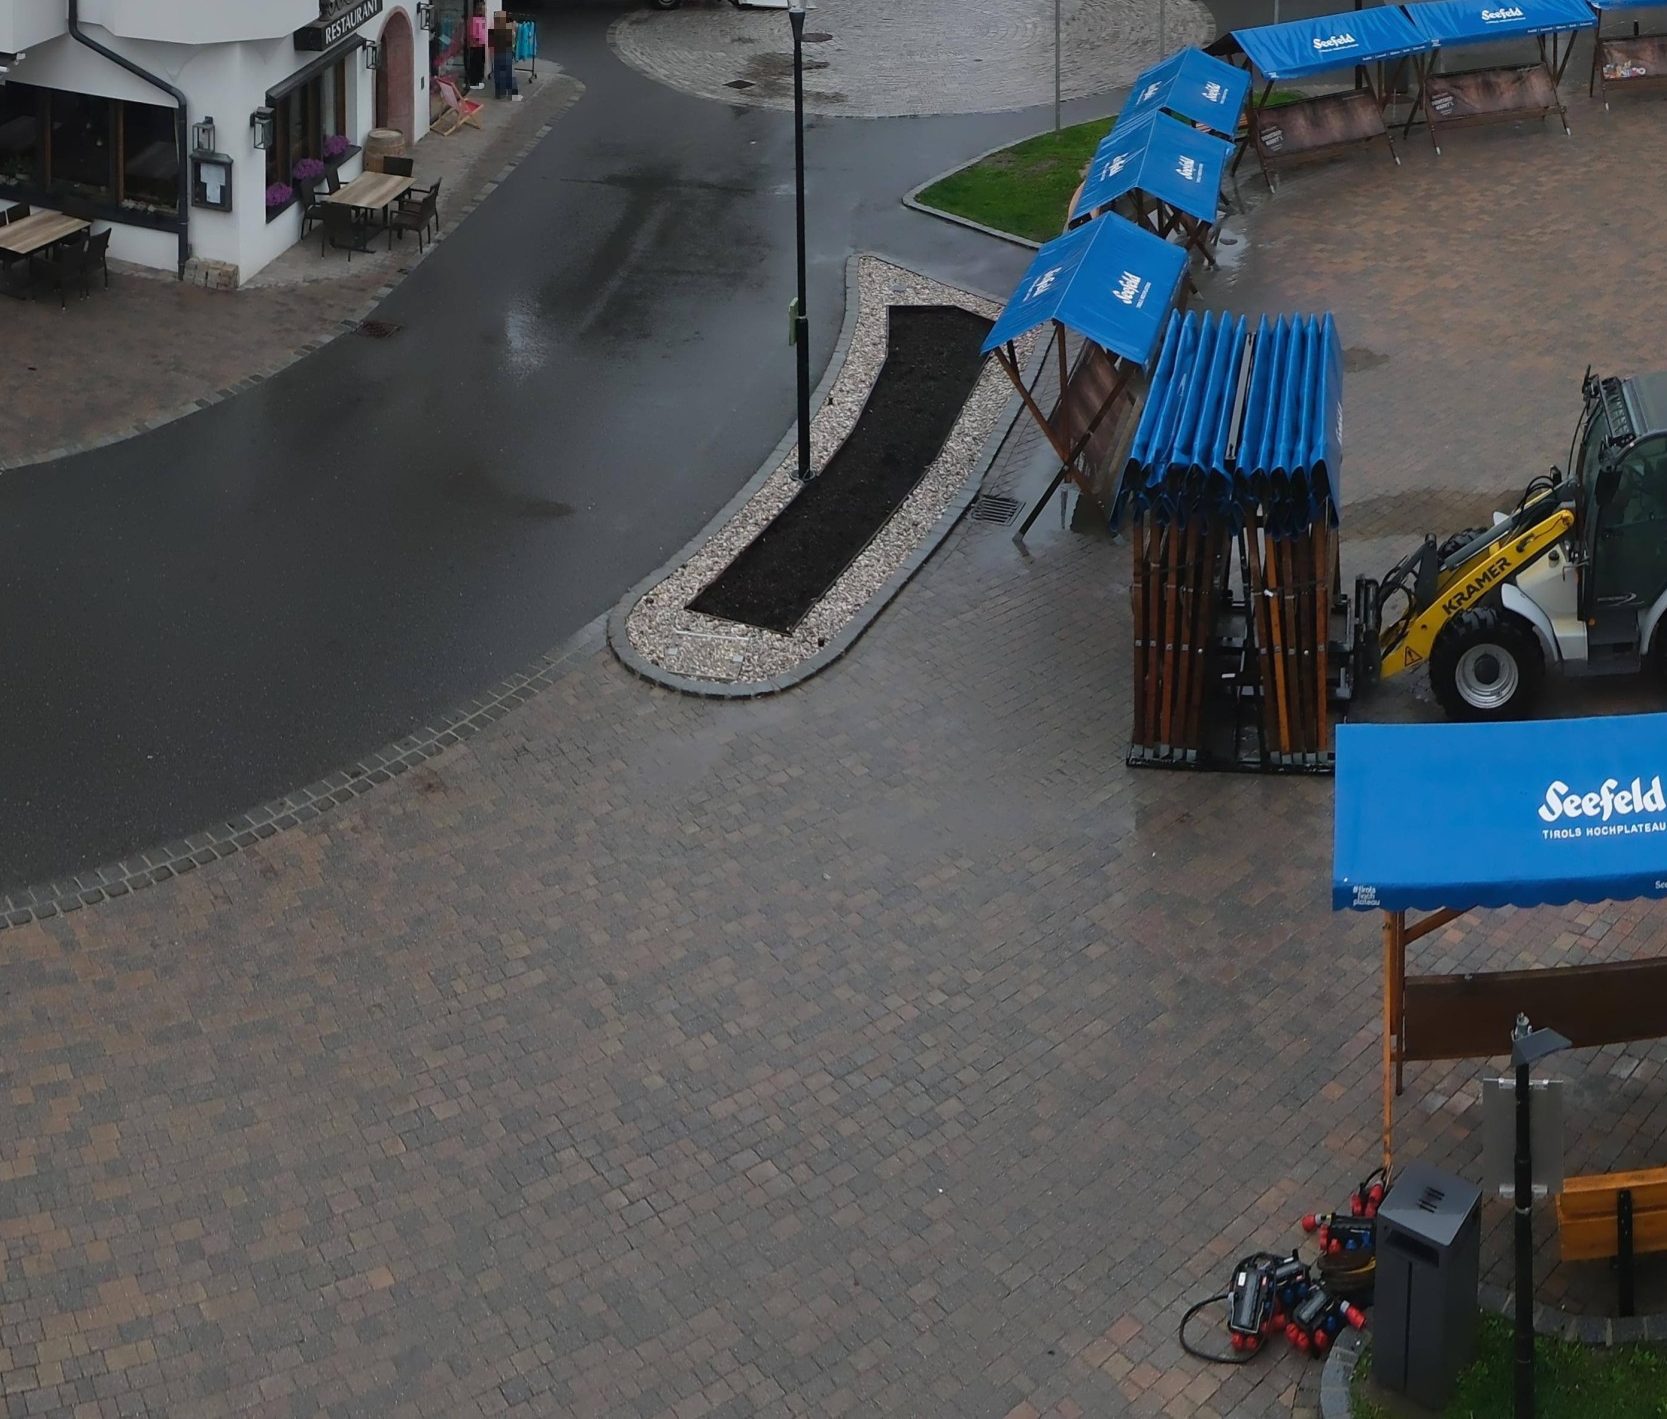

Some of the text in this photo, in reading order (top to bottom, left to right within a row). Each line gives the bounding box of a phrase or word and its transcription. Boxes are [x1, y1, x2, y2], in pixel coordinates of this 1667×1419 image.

[1481, 7, 1524, 21] Seefeld
[1313, 33, 1356, 49] Seefeld
[1441, 556, 1513, 615] KRAMER
[1537, 775, 1667, 823] Seefeld
[1542, 821, 1667, 840] TIROLS HOCHPLATEAU
